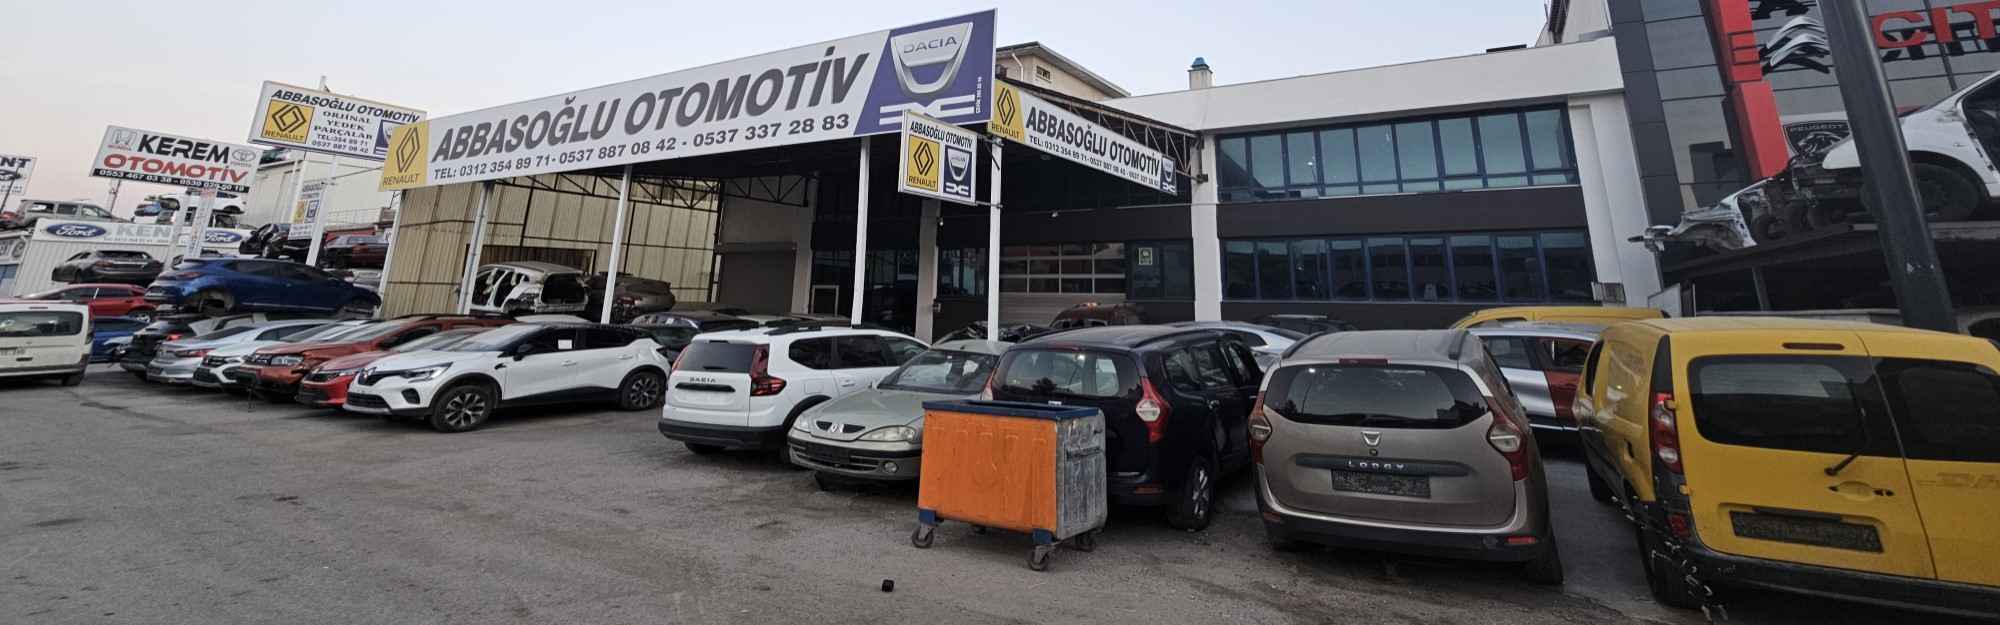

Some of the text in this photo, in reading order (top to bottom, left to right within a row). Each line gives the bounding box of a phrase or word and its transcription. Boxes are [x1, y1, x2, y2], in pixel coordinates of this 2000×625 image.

[904, 36, 957, 53] DACIA
[272, 89, 420, 123] ABBASOĞLU OTOMOTİV
[431, 46, 870, 163] ABBASOĞLU OTOMOTİV
[314, 125, 373, 140] PARÇALAR
[326, 119, 365, 131] YEDEK
[992, 122, 1019, 139] RENAULT
[264, 129, 305, 142] RENAULT
[910, 121, 972, 149] ABBASOĞLU OTOMOTİV
[1026, 106, 1159, 177] ABBASOĞLU OTOMOTİV
[137, 134, 231, 164] KEREM
[434, 168, 457, 180] TEL:
[459, 163, 486, 177] 0312
[489, 159, 511, 173] 354
[515, 157, 531, 170] 89
[559, 149, 594, 164] 0537
[598, 144, 626, 159] 887
[631, 141, 650, 155] 08
[656, 137, 676, 152] 42
[693, 129, 739, 147] 0537
[745, 123, 781, 141] 337
[788, 118, 815, 135] 28
[822, 114, 849, 131] 83
[104, 153, 249, 184] OTOMOTİV
[383, 173, 420, 186] RENAULT
[908, 175, 937, 188] RENAULT
[56, 224, 95, 238] Ford
[1348, 460, 1405, 469] LODGY
